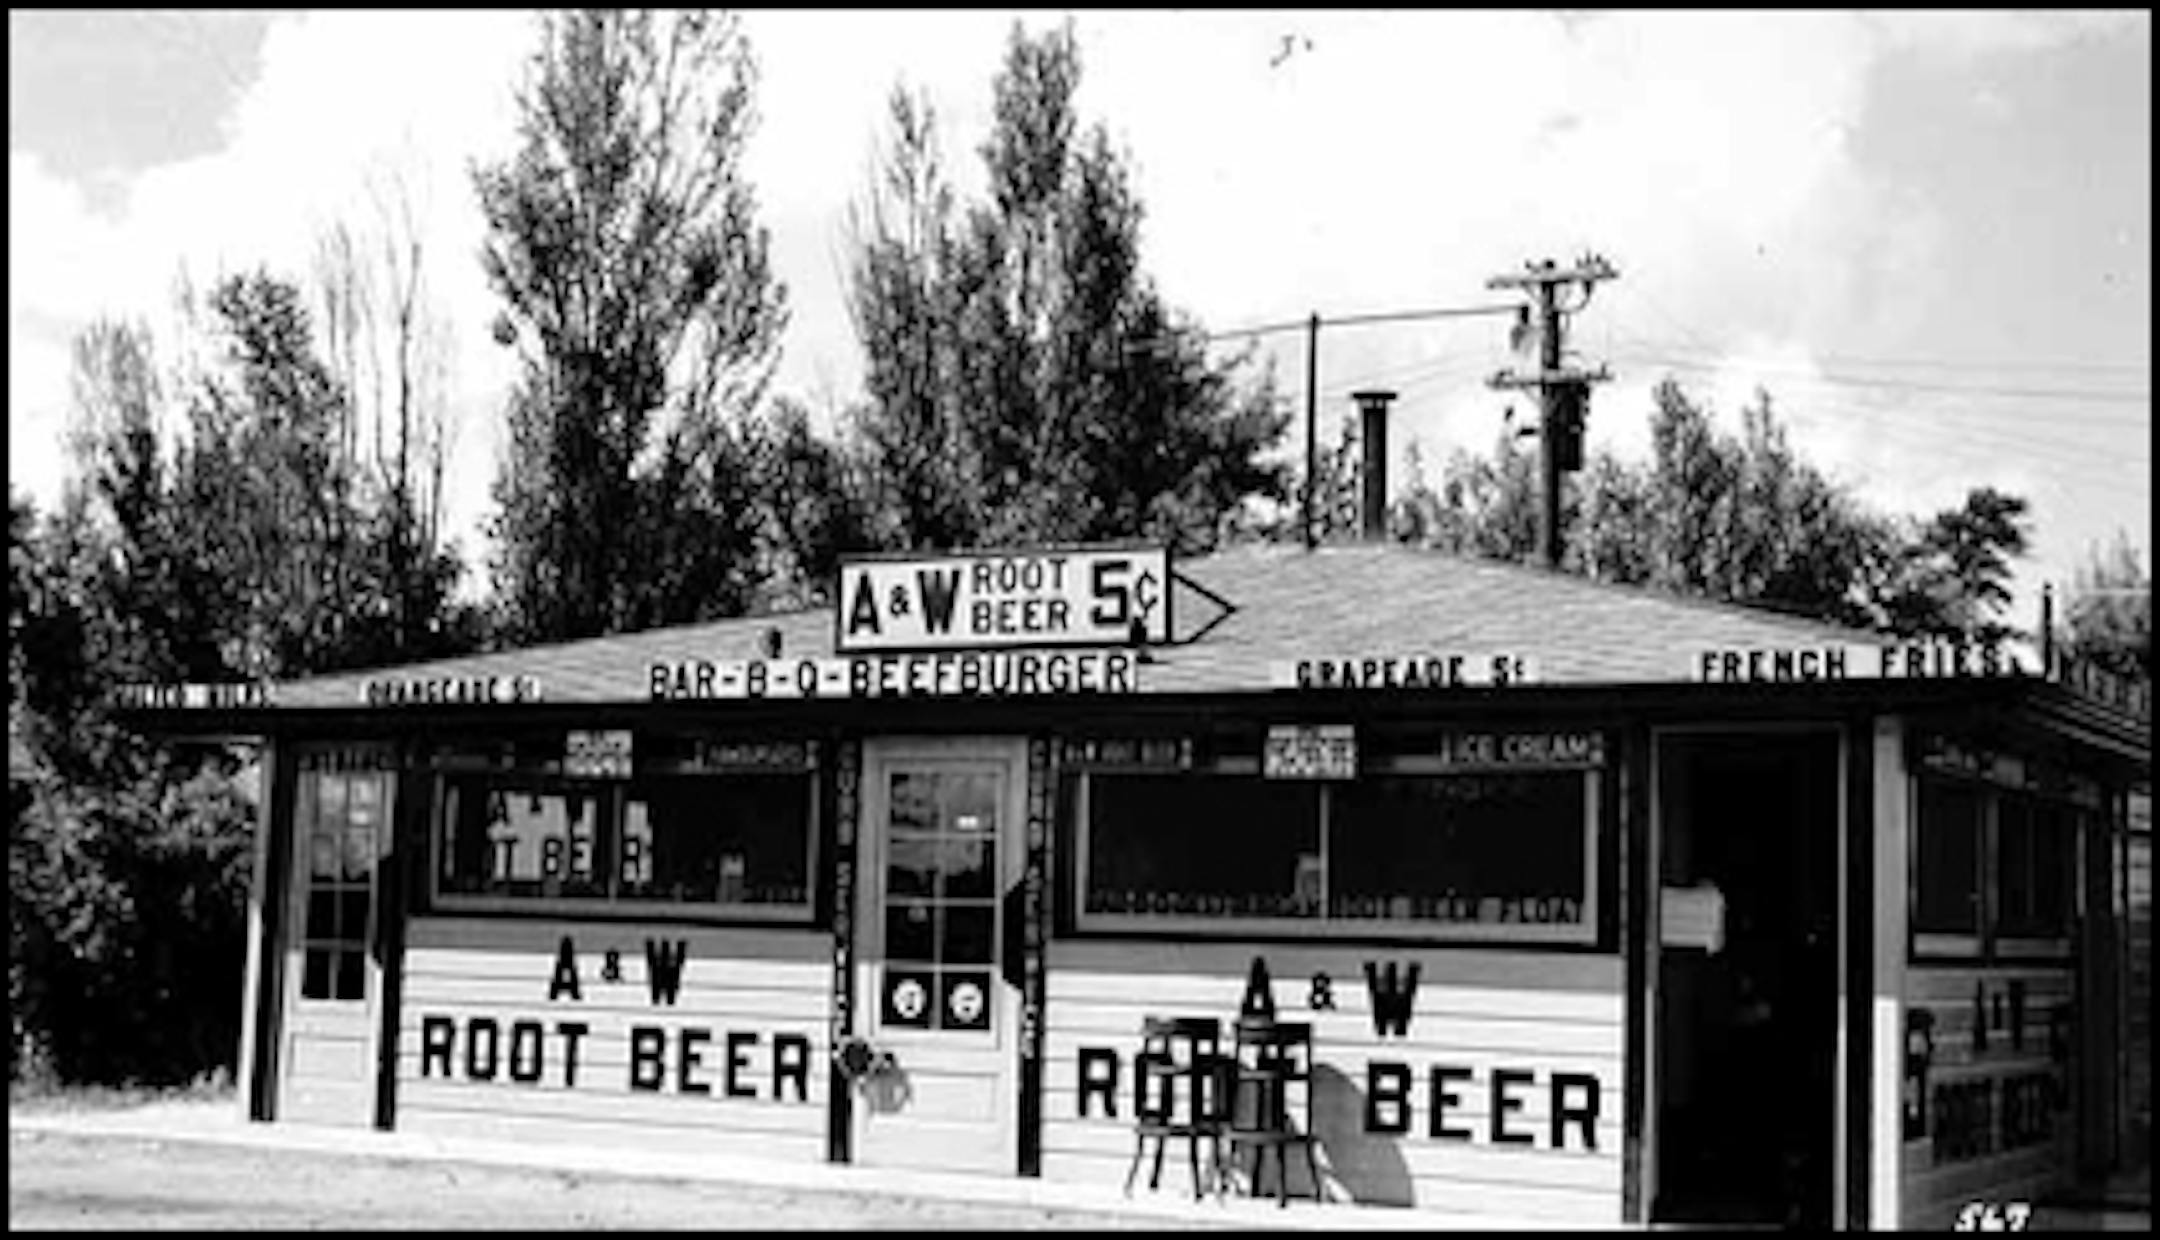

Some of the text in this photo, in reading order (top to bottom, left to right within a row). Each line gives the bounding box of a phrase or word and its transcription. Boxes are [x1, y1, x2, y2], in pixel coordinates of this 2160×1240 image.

[972, 558, 1068, 594] ROOT
[971, 600, 1067, 634] BEER
[1702, 650, 1845, 681] FRENCH
[1501, 733, 1590, 764] CREAM
[422, 1016, 810, 1102] ROOT BEER
[1364, 1061, 1600, 1151] BEER
